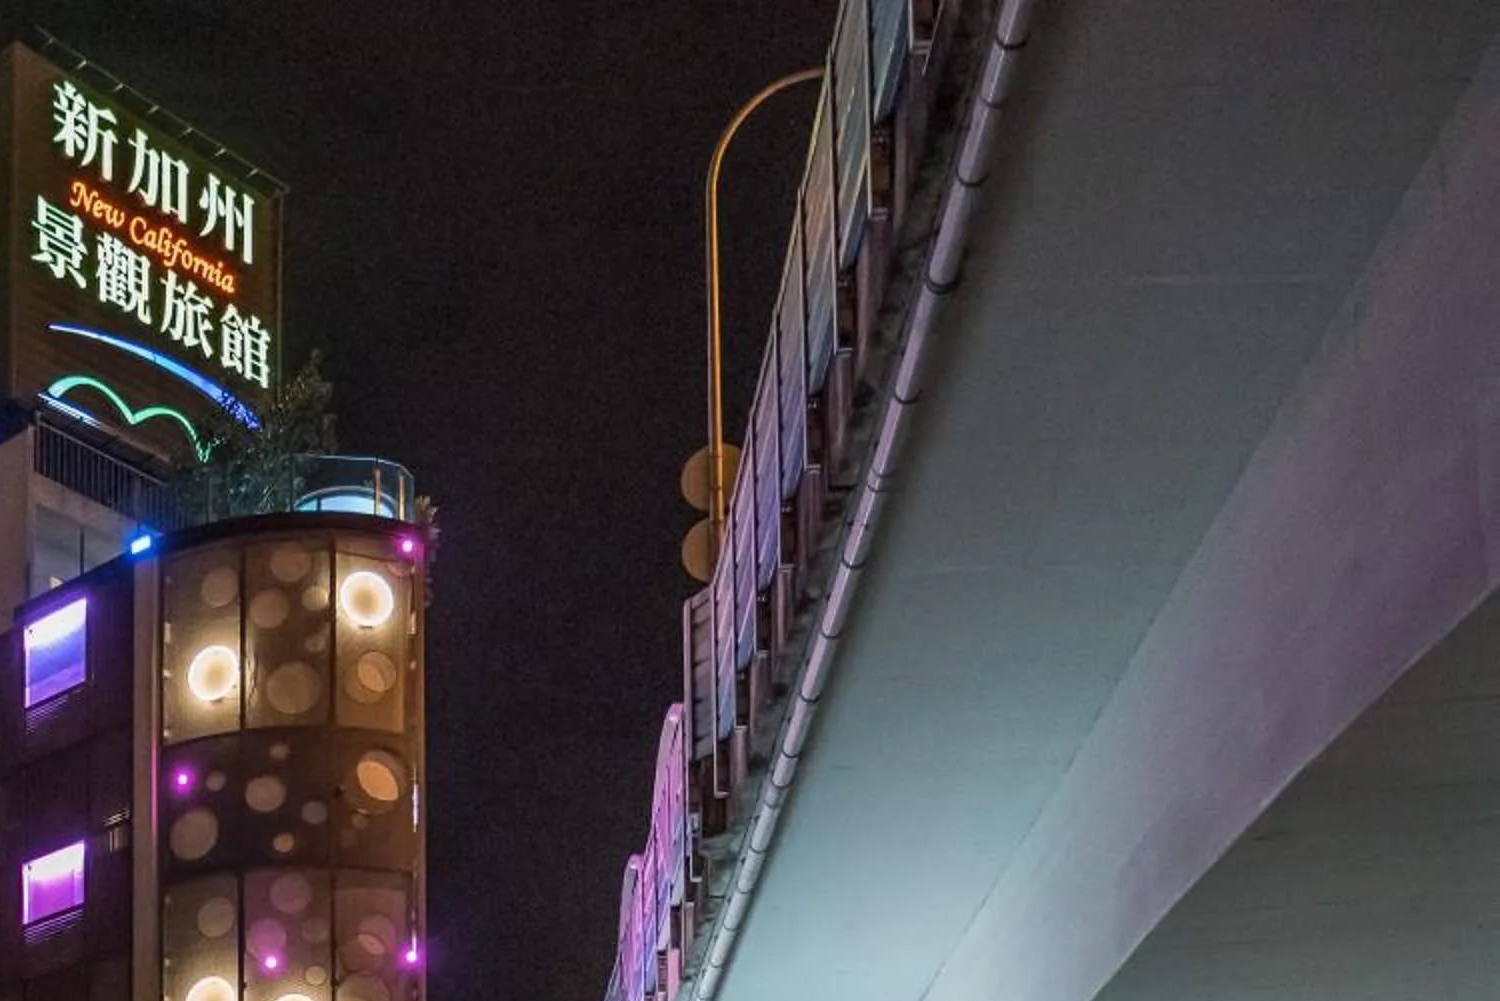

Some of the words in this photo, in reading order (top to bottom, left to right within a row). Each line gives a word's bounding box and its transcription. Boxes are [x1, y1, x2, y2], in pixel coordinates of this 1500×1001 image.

[53, 80, 255, 264] 新加州
[69, 181, 125, 228] New
[129, 216, 235, 293] California
[31, 195, 271, 389] 景觀旅館
